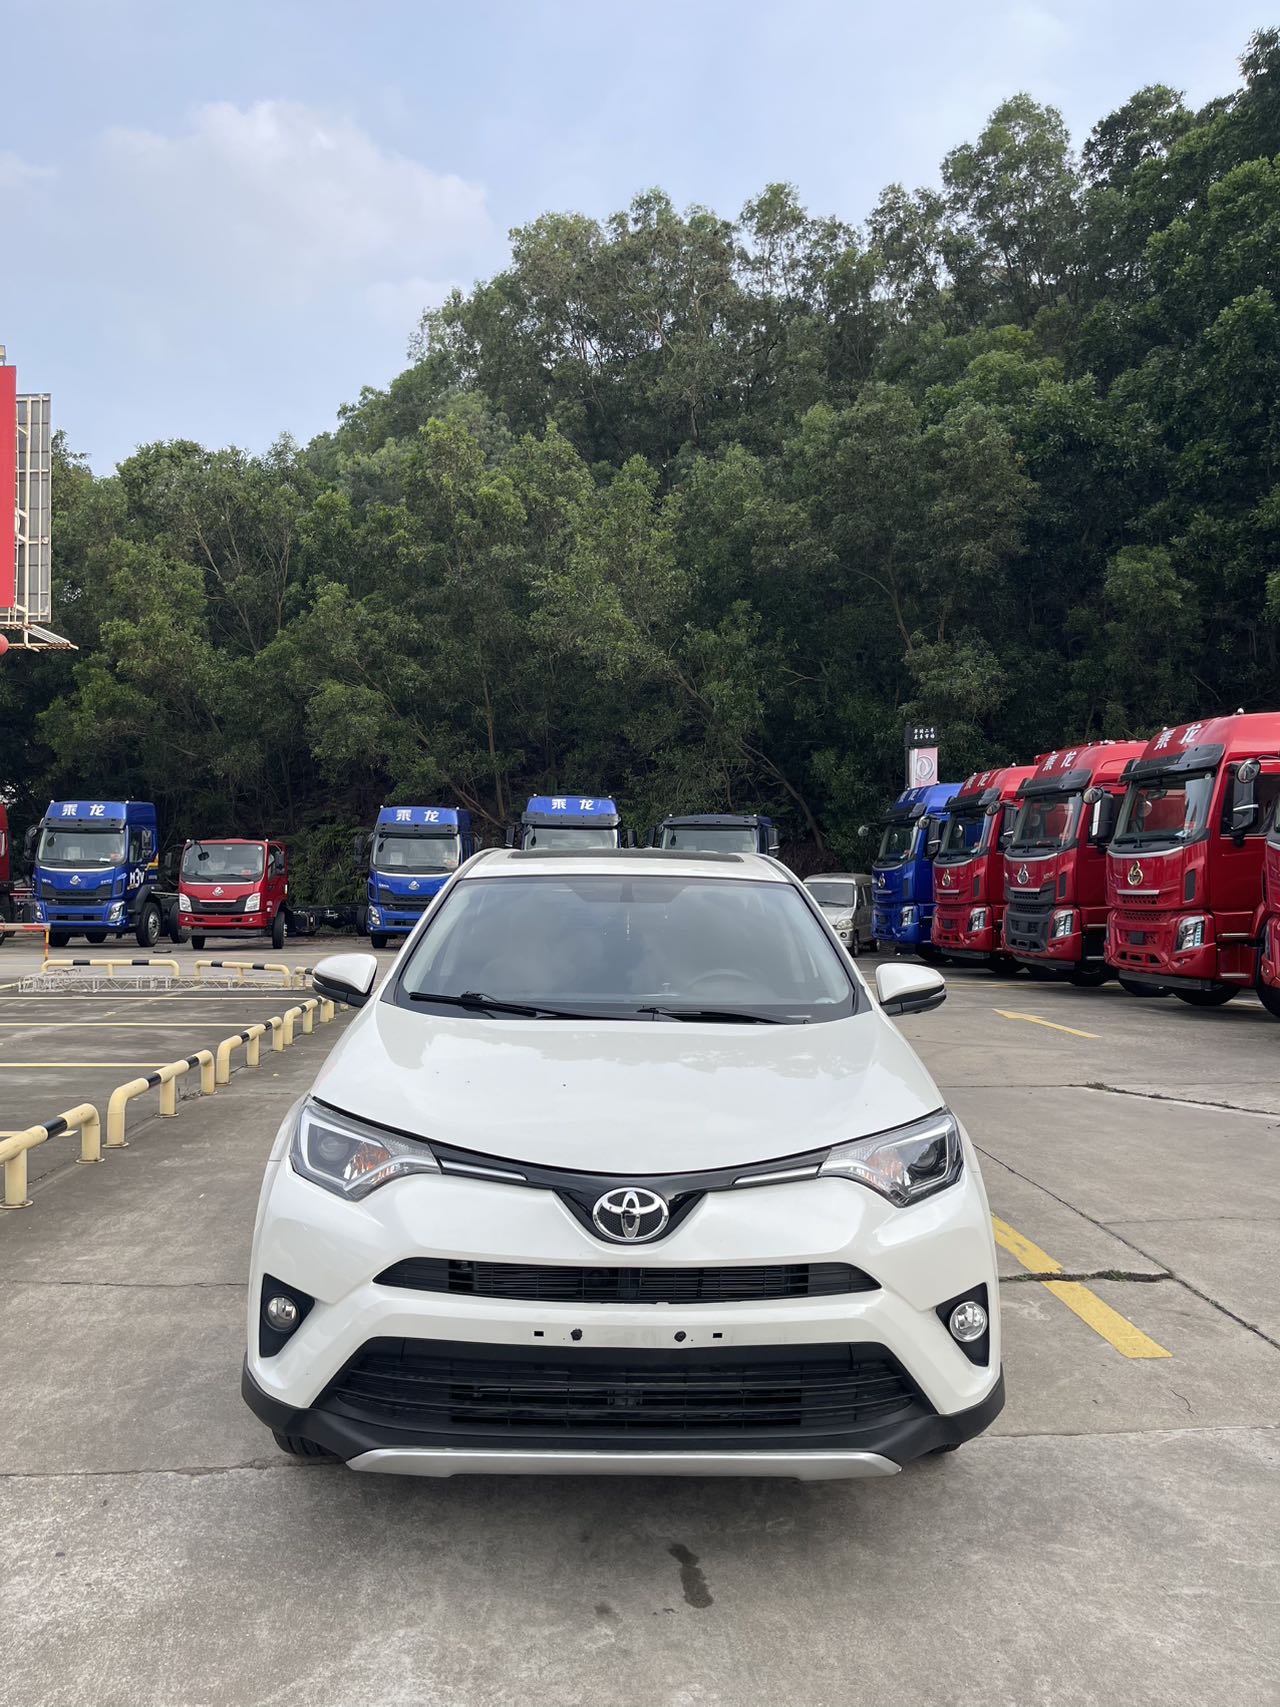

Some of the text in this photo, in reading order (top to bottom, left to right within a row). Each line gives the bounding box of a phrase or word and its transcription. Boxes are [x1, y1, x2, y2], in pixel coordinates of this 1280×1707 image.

[1154, 723, 1202, 750] 乘龙
[1043, 750, 1077, 772] 乘龙
[61, 803, 105, 817] 乘龙
[551, 798, 595, 811] 乘龙
[396, 809, 440, 823] 乘龙
